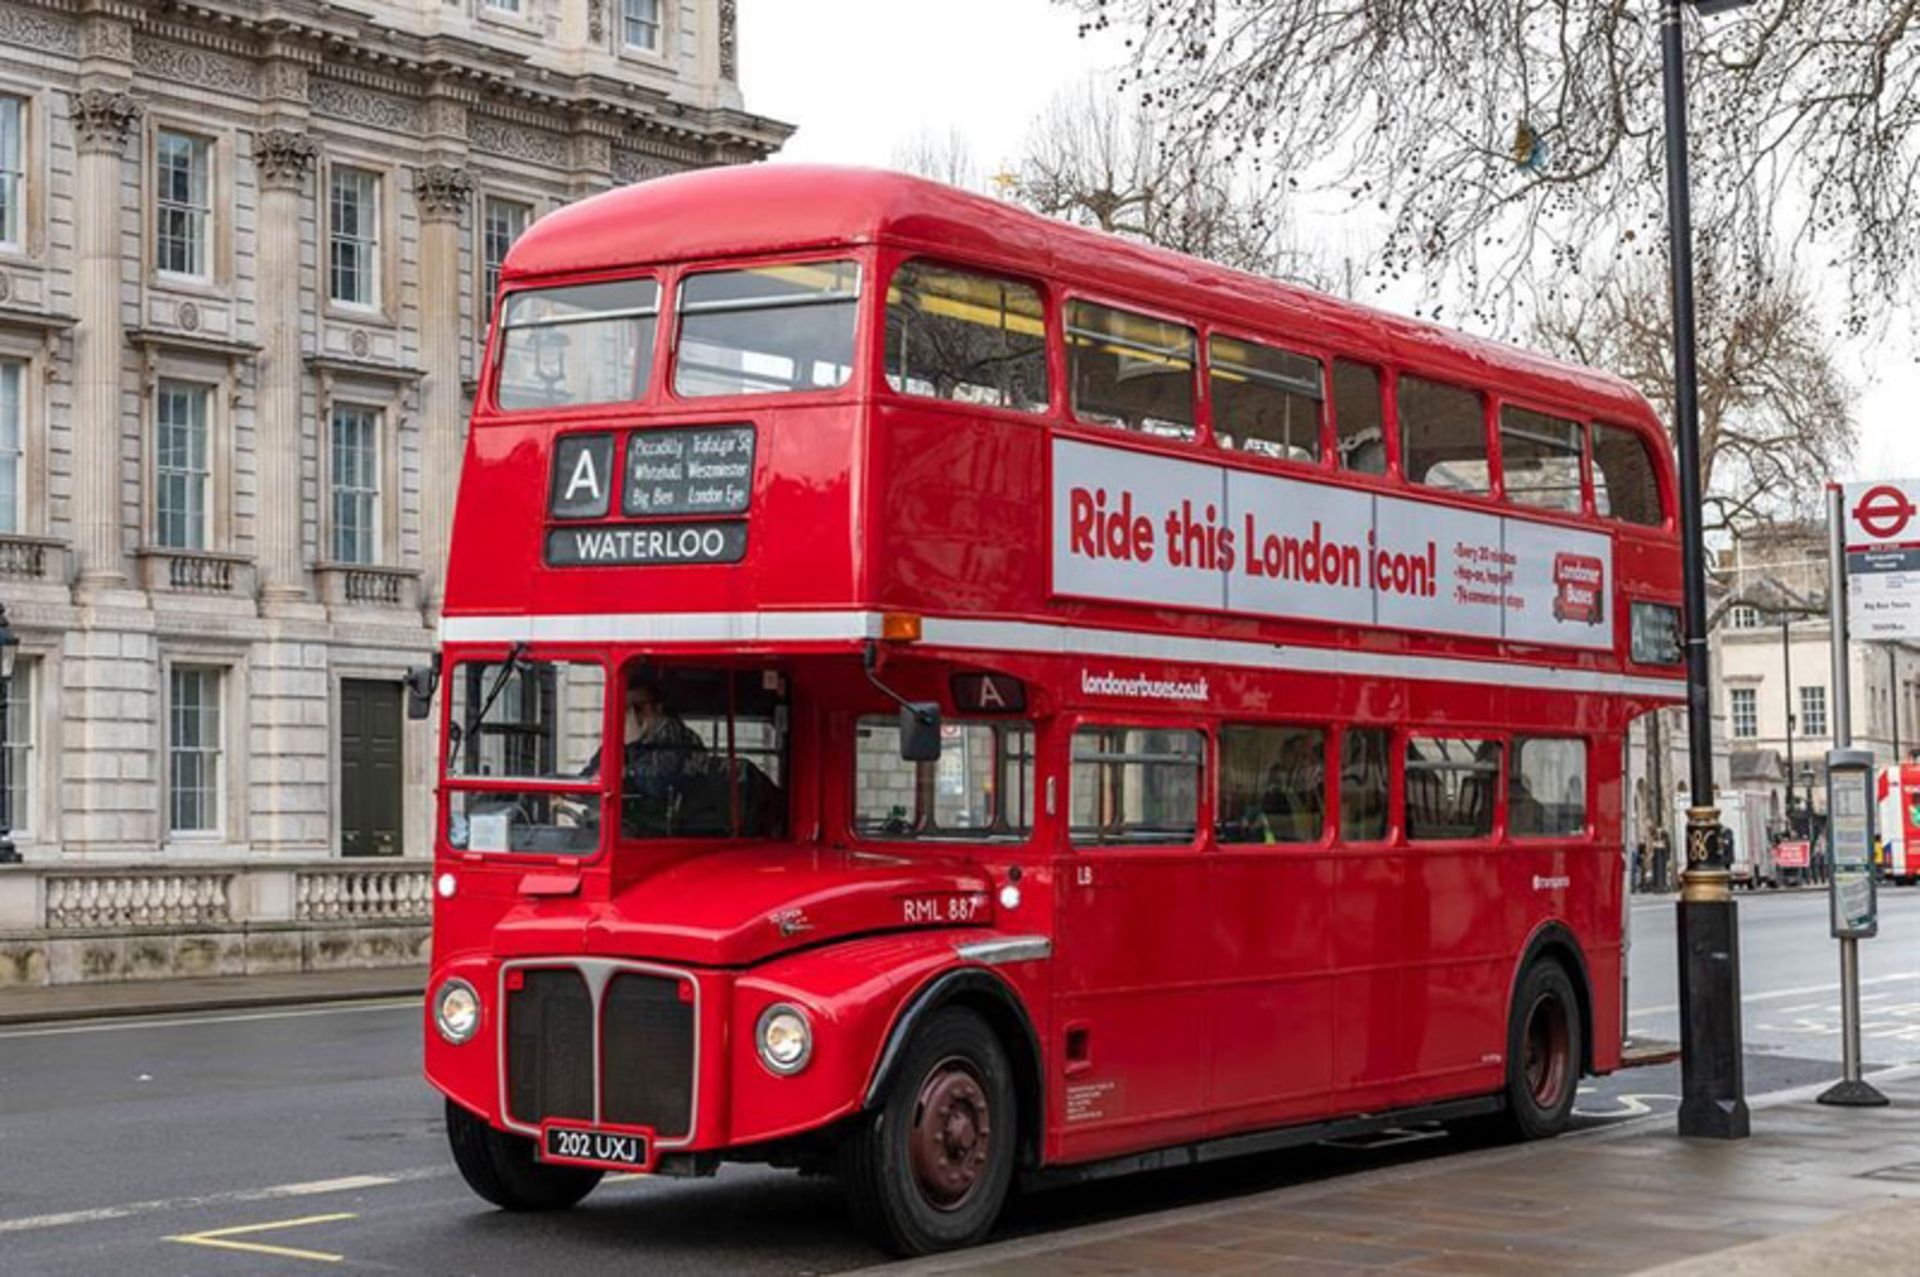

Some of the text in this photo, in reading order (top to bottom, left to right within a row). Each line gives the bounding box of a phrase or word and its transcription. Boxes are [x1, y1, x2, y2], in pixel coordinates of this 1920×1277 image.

[634, 438, 683, 459] Piccadilly
[693, 434, 736, 457] Trafalgar
[565, 449, 599, 500] A
[635, 461, 748, 480] Whitehall Westminster
[633, 484, 744, 509] Big Ben London Eye
[575, 529, 725, 560] WATERLOO
[1070, 487, 1437, 597] Ride this London icon!
[980, 675, 1006, 707] A
[1082, 669, 1209, 701] londonerbuses.co.uk
[904, 897, 976, 921] RML 887
[558, 1132, 637, 1162] 202 UXJ
